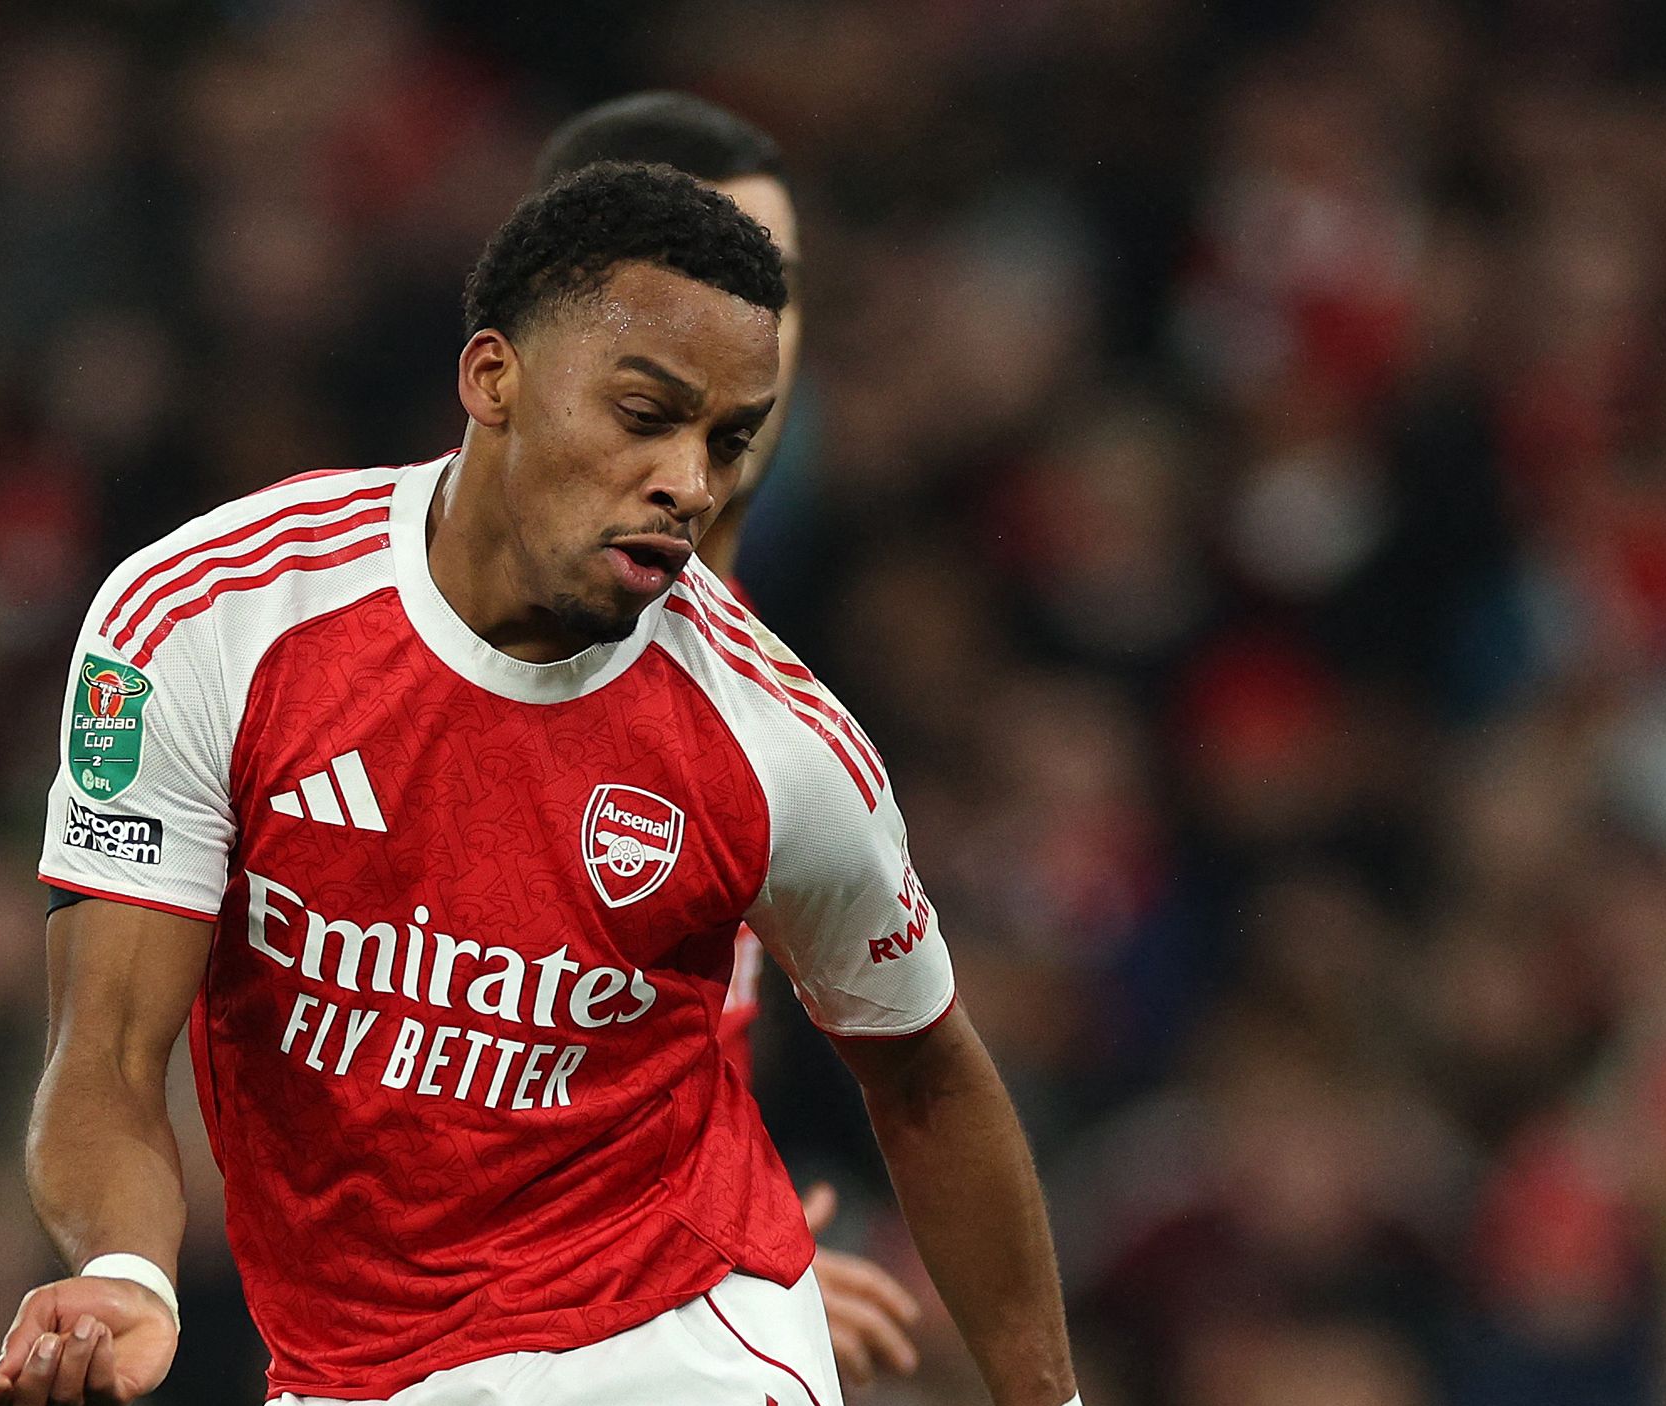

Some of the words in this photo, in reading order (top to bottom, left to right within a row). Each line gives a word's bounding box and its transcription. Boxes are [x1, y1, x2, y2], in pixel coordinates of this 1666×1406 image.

[74, 712, 136, 730] Carabao
[84, 732, 114, 751] Cup
[92, 755, 102, 767] 2
[94, 776, 112, 792] EFL
[599, 801, 670, 839] Arsenal
[244, 868, 657, 1029] Emirates
[280, 992, 379, 1076] FLY
[380, 1017, 588, 1110] BETTER
